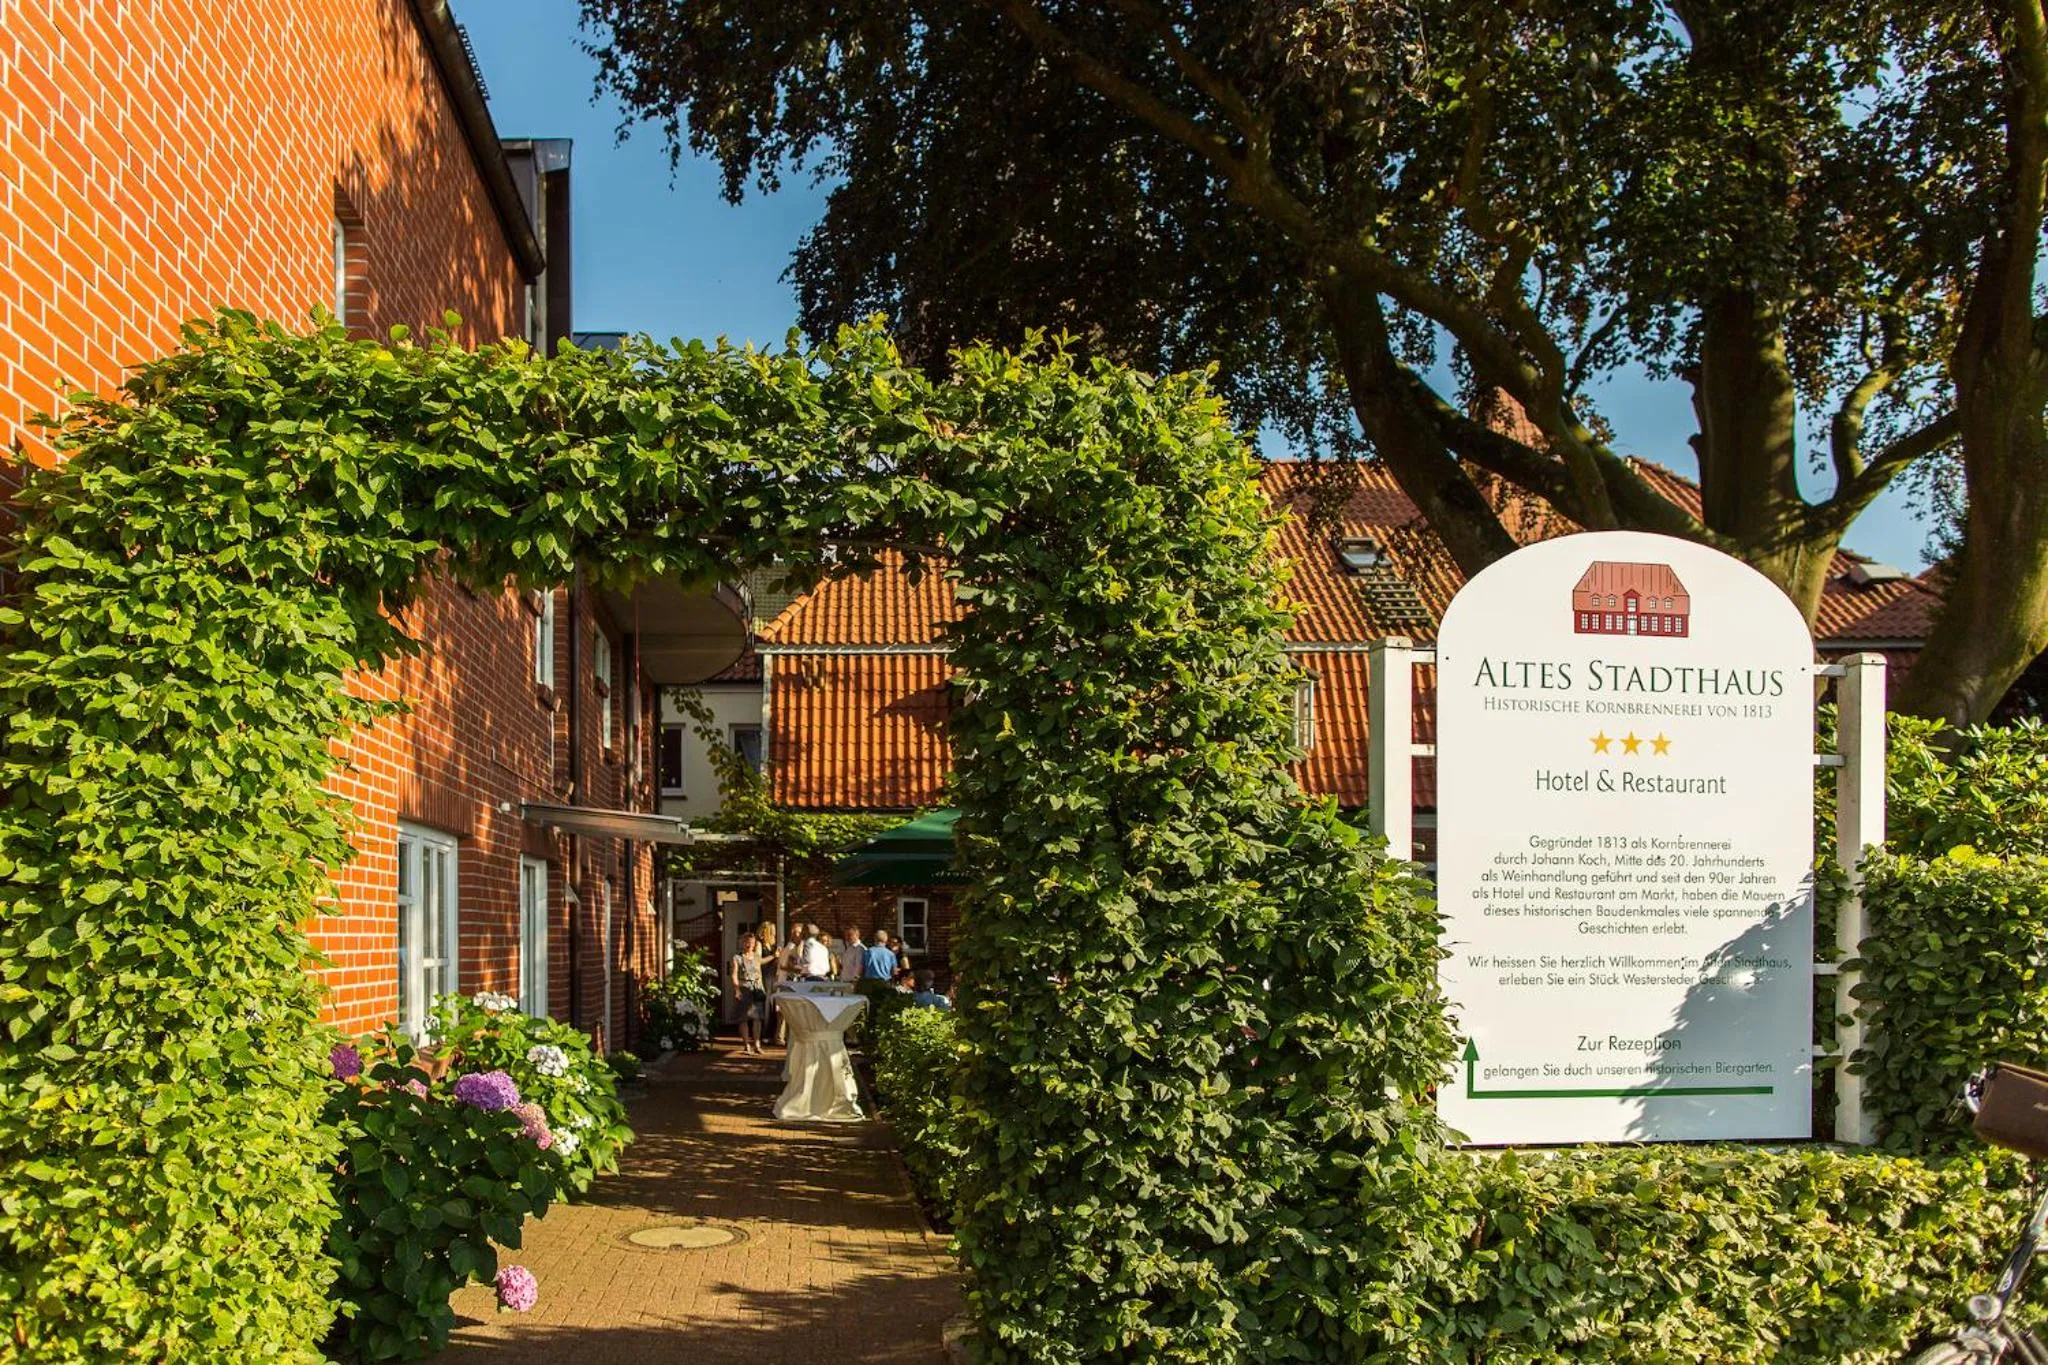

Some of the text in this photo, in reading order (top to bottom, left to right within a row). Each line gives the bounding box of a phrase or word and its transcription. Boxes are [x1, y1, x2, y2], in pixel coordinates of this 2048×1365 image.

[1473, 656, 1783, 697] ALTES STADTHAUS
[1484, 696, 1773, 719] HISTORISCHE KORNBRENNEREI VON 1813
[1536, 768, 1727, 795] Hotel & Restaurant
[1528, 834, 1732, 852] Gegründet 1813 als Kornbrennerei
[1493, 851, 1766, 868] durch Johann Koch, Mitte des 20. Jahrhunderts
[1480, 868, 1777, 886] als Weinhandlung geführt und seit den 90er Jahren
[1471, 886, 1786, 902] als Hotel und Restaurant am Markt, haben die Mauern
[1483, 903, 1521, 917] dieses
[1523, 903, 1593, 917] historischen
[1595, 904, 1681, 918] Baudenkmales
[1682, 904, 1710, 918] viele
[1577, 920, 1689, 935] Geschichten erlebt.
[1466, 955, 1490, 968] Wir
[1492, 955, 1537, 969] heissen
[1539, 955, 1558, 969] Sie
[1560, 954, 1606, 969] herzlich
[1685, 956, 1700, 969] im
[1498, 972, 1544, 986] erleben
[1546, 972, 1565, 986] Sie
[1567, 972, 1586, 986] ein
[1588, 972, 1621, 986] Stück
[1622, 971, 1695, 984] Westersteder
[1576, 1034, 1682, 1055] Zur Rezeption
[1483, 1063, 1540, 1080] gelangen
[1542, 1062, 1562, 1077] Sie
[1563, 1062, 1593, 1077] duch
[1595, 1065, 1642, 1076] unseren
